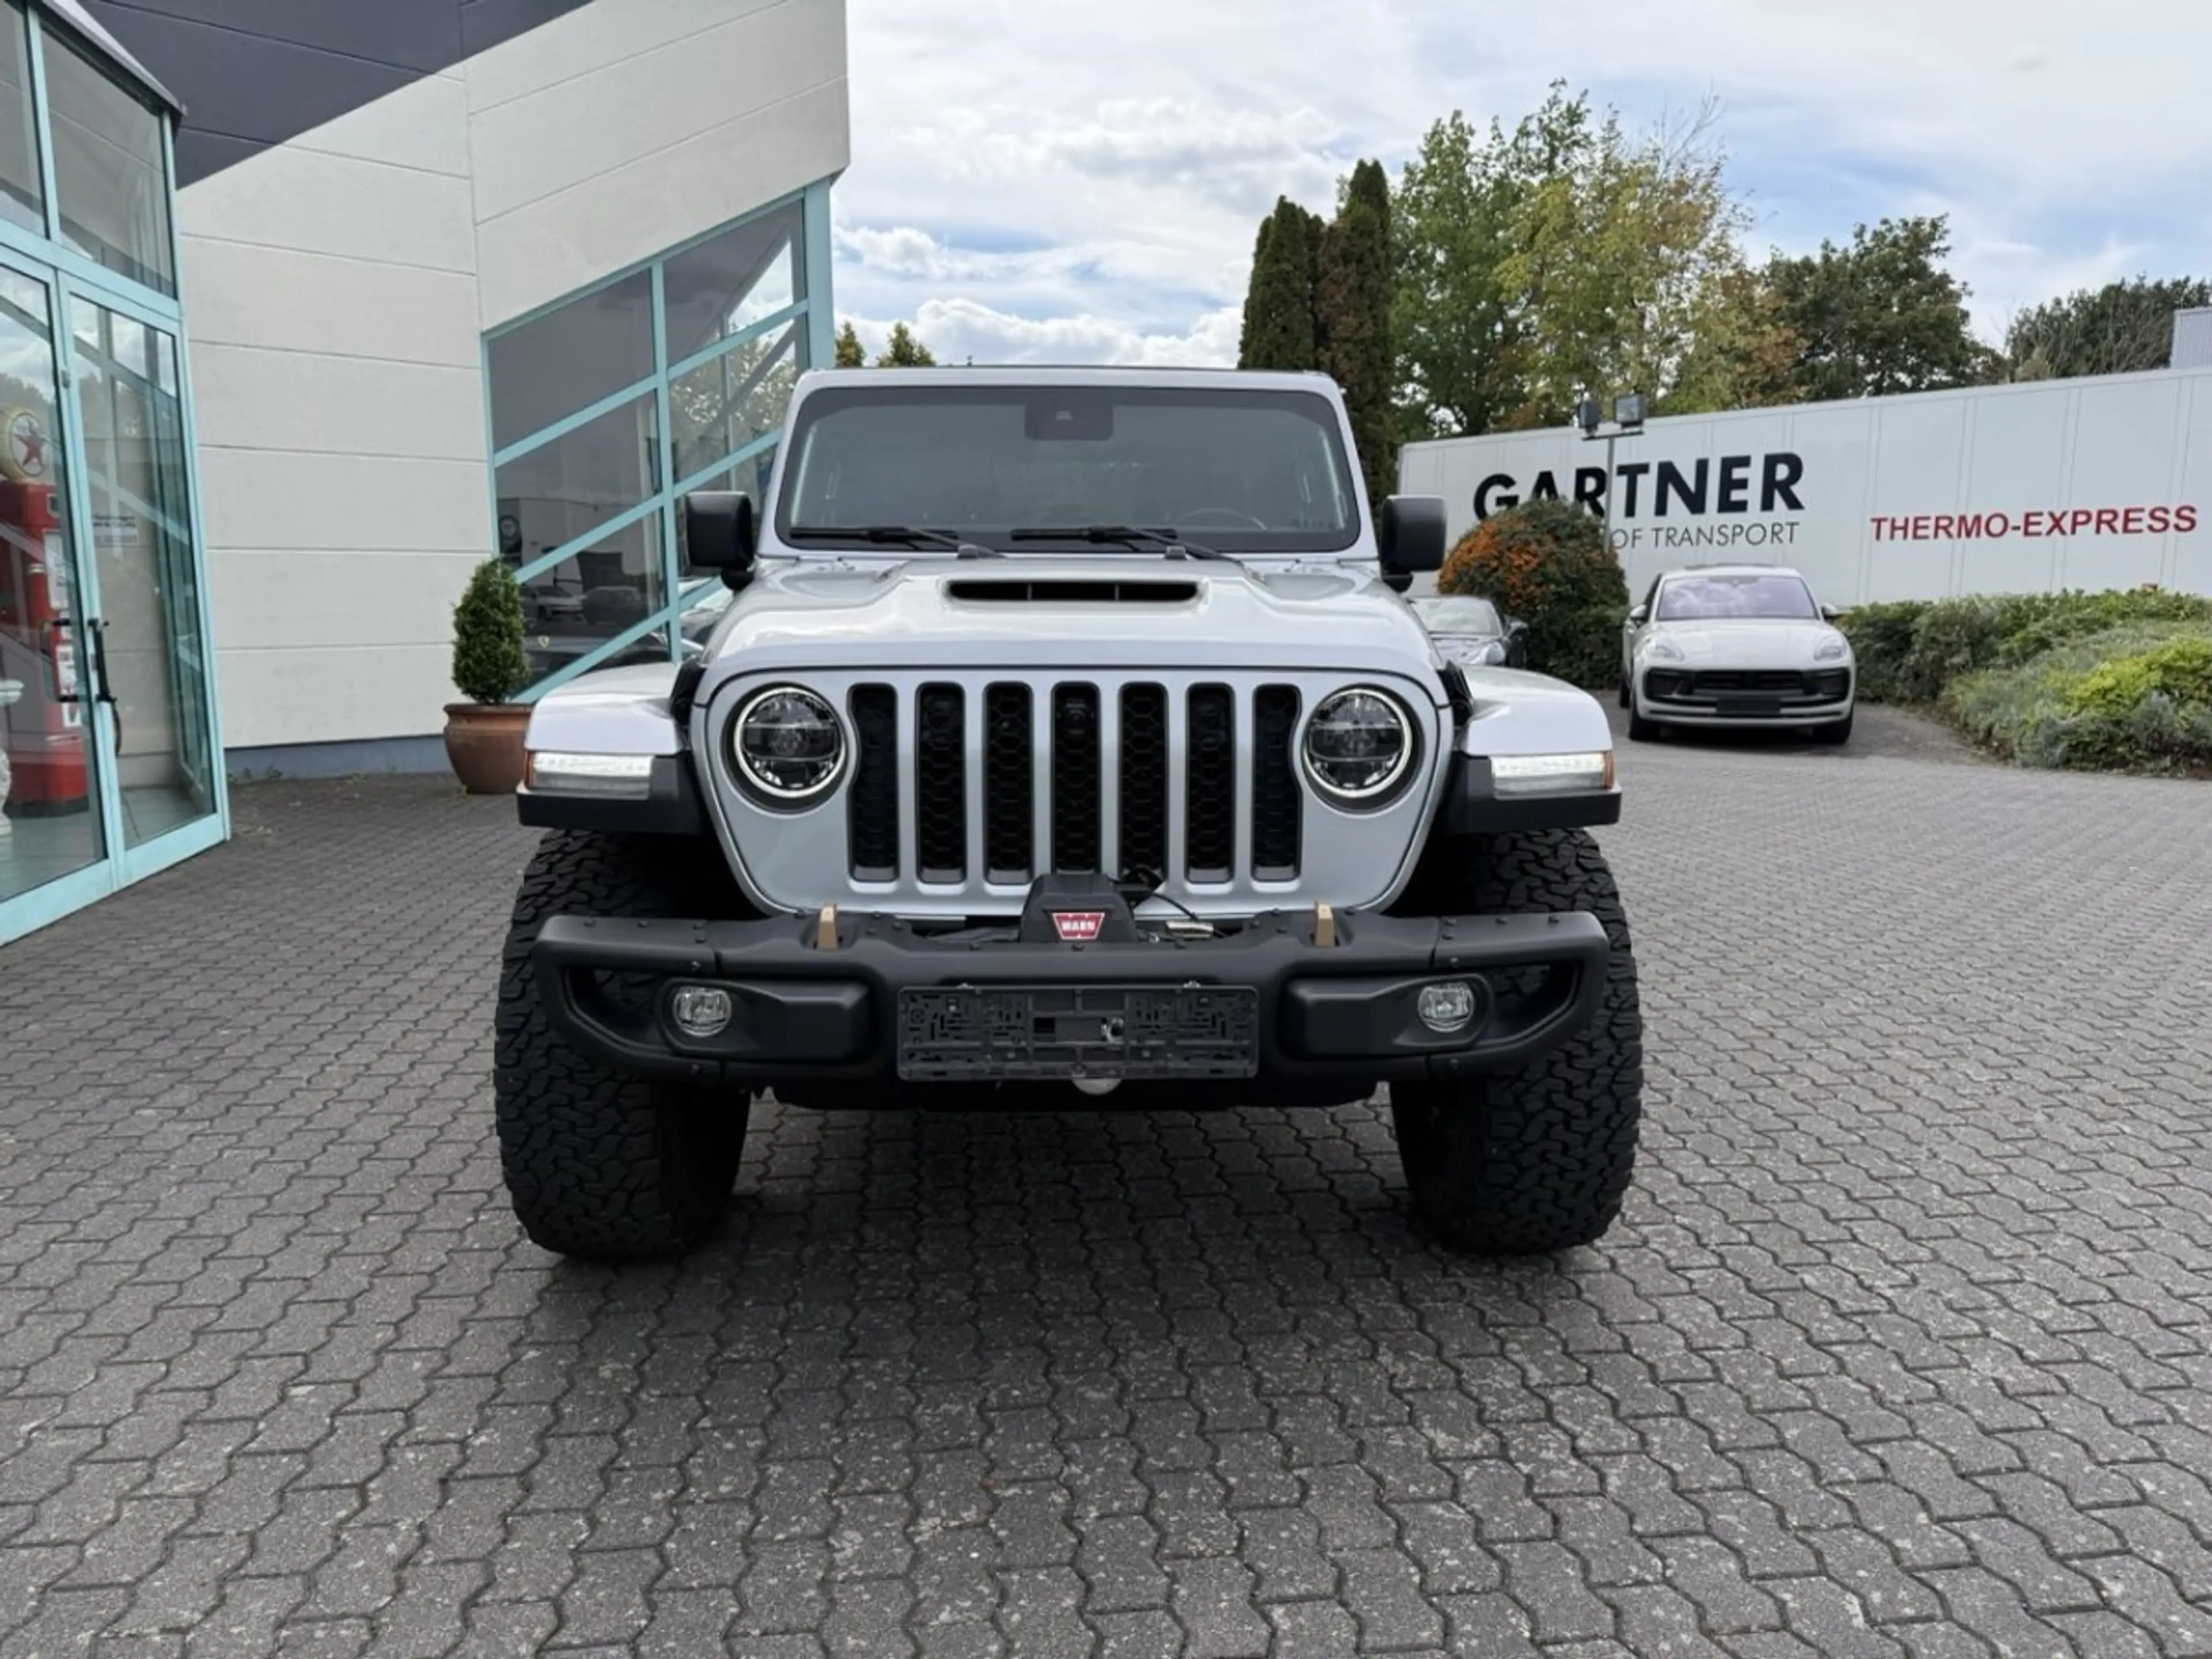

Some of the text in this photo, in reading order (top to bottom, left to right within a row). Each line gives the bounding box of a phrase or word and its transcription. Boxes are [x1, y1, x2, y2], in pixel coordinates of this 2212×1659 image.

[1610, 521, 1800, 550] OF TRANSPORT
[1870, 505, 2198, 541] THERMO-EXPRESS
